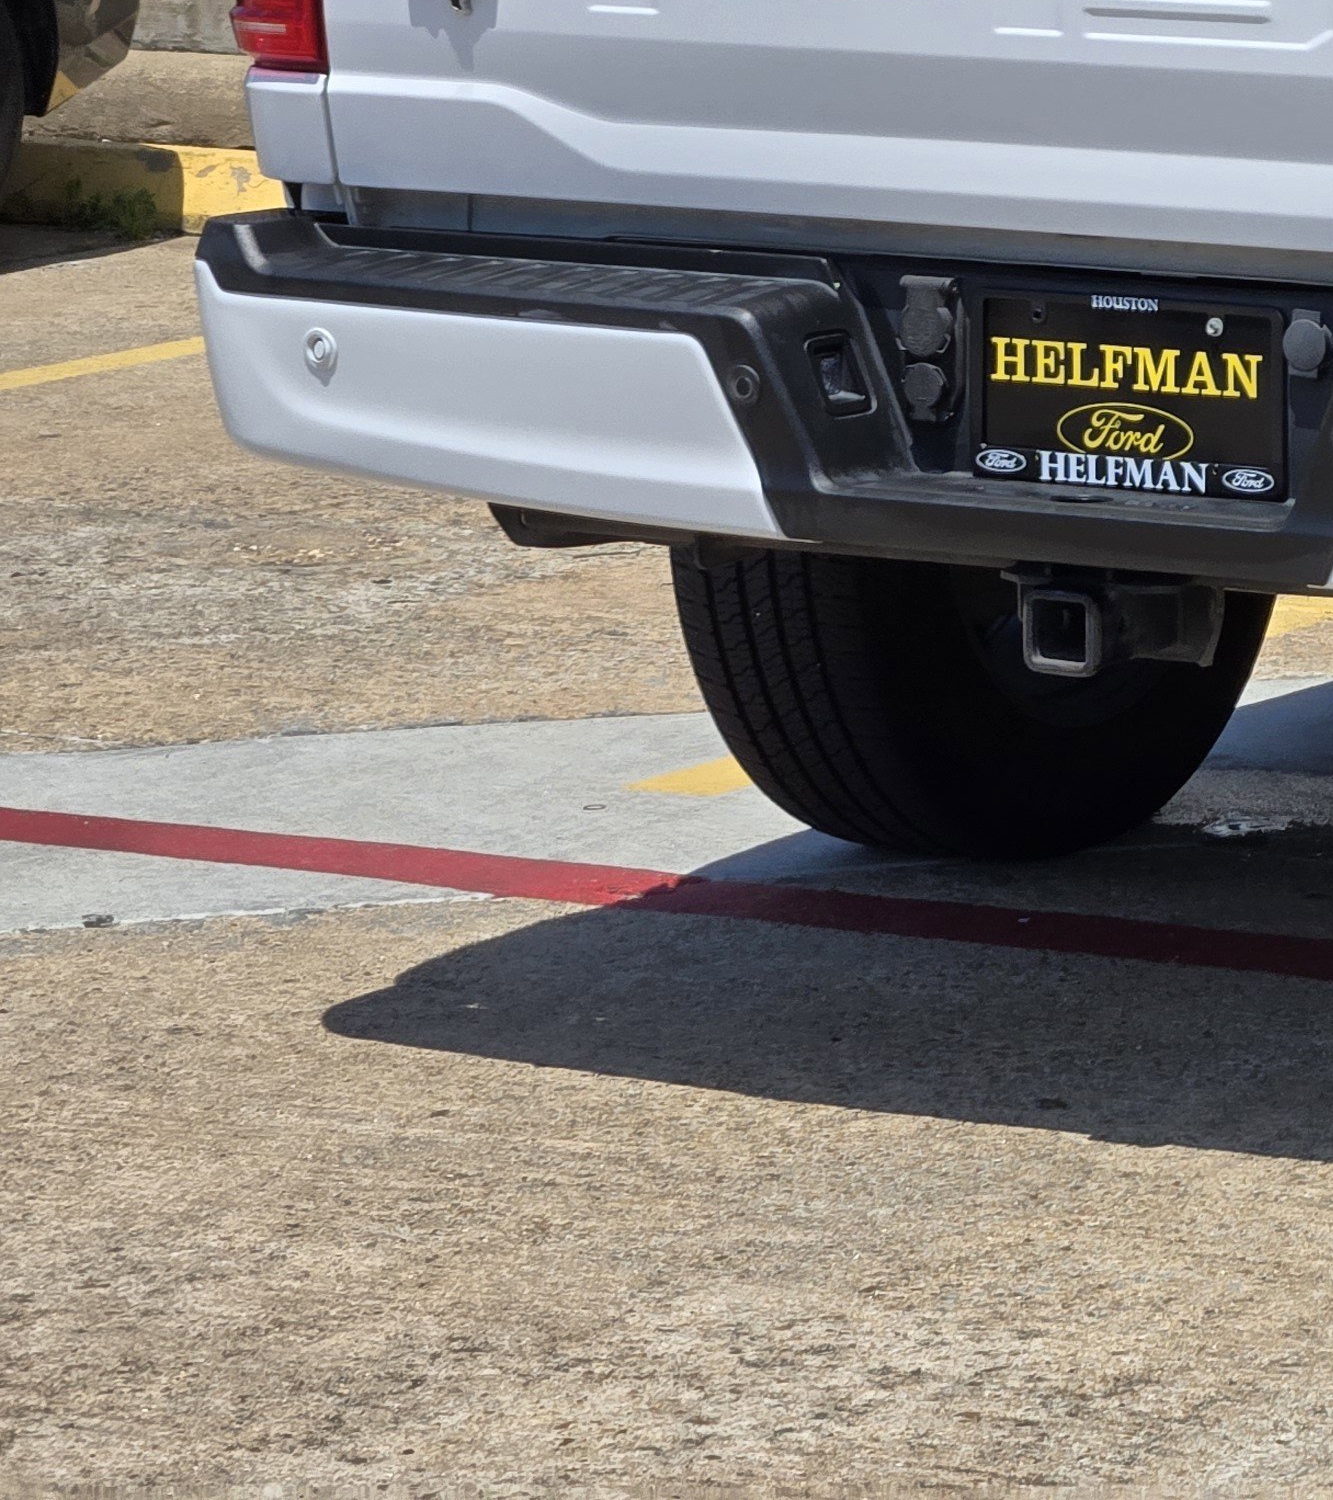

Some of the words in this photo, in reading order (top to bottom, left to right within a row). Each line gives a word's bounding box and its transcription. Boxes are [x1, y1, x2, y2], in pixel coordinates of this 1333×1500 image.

[1091, 294, 1159, 312] HOUSTON
[990, 336, 1263, 399] HELFMAN
[1083, 408, 1165, 454] Ford
[985, 451, 1017, 470] Ford
[1038, 450, 1210, 494] HELFMAN
[1232, 471, 1264, 489] Ford
